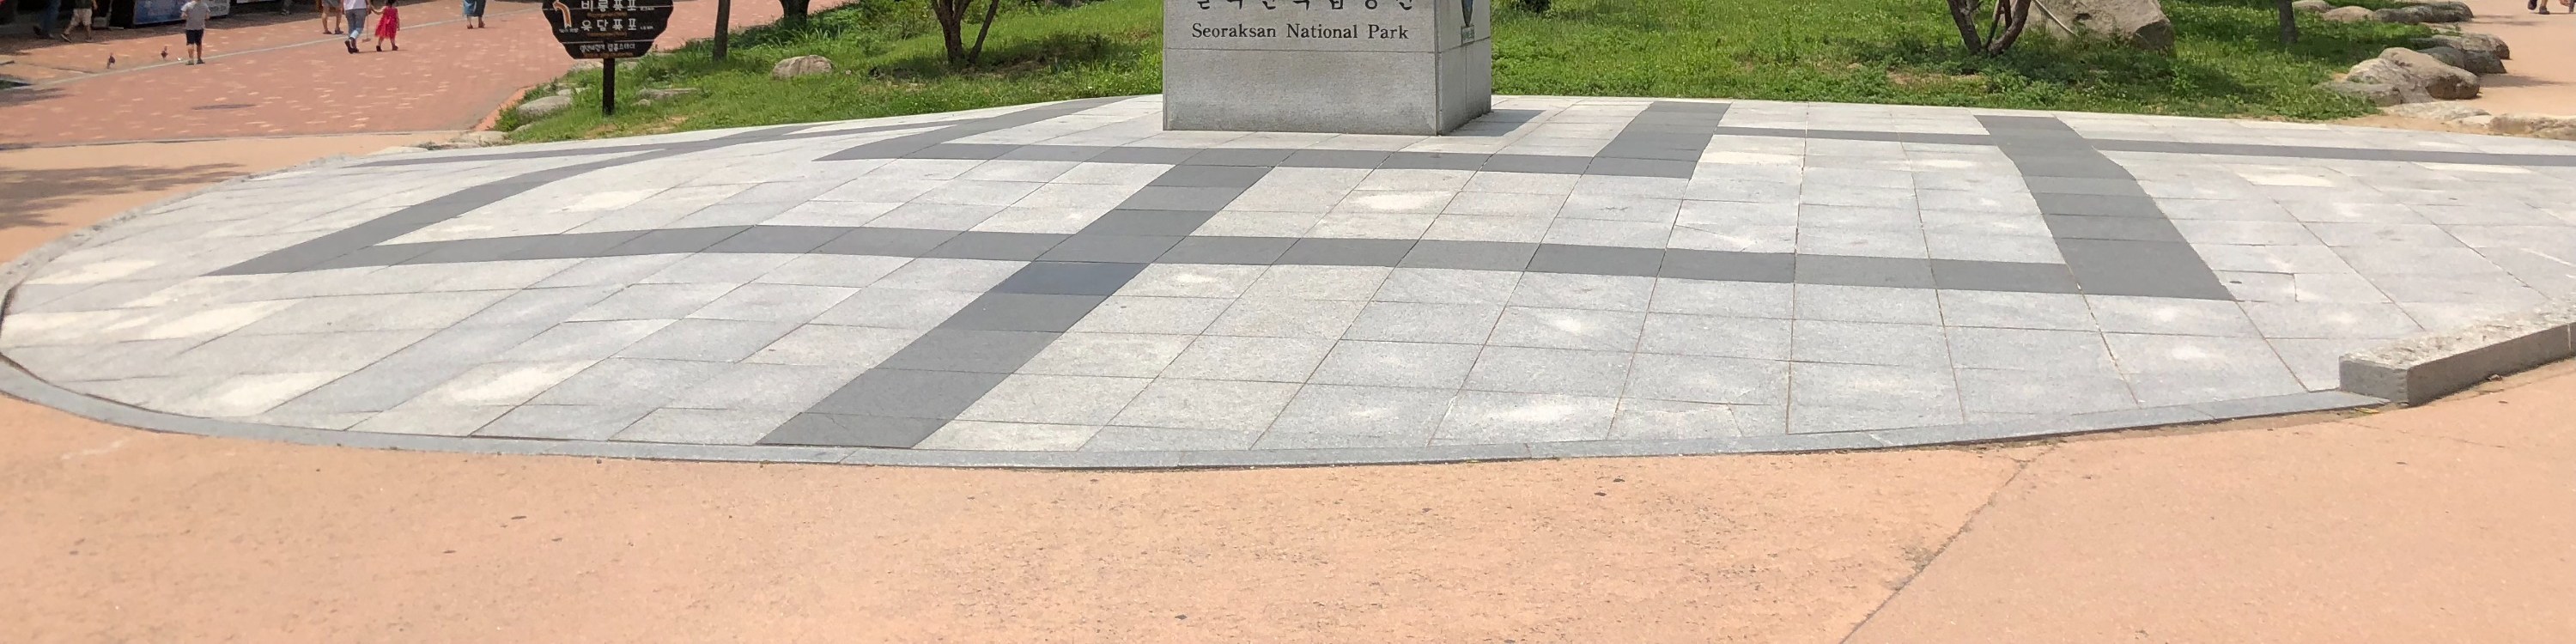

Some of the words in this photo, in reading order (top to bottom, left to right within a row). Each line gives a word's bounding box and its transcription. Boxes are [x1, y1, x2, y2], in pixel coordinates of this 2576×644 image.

[1192, 23, 1276, 38] Seoraksan
[1286, 23, 1358, 39] National
[1368, 24, 1409, 39] Park
